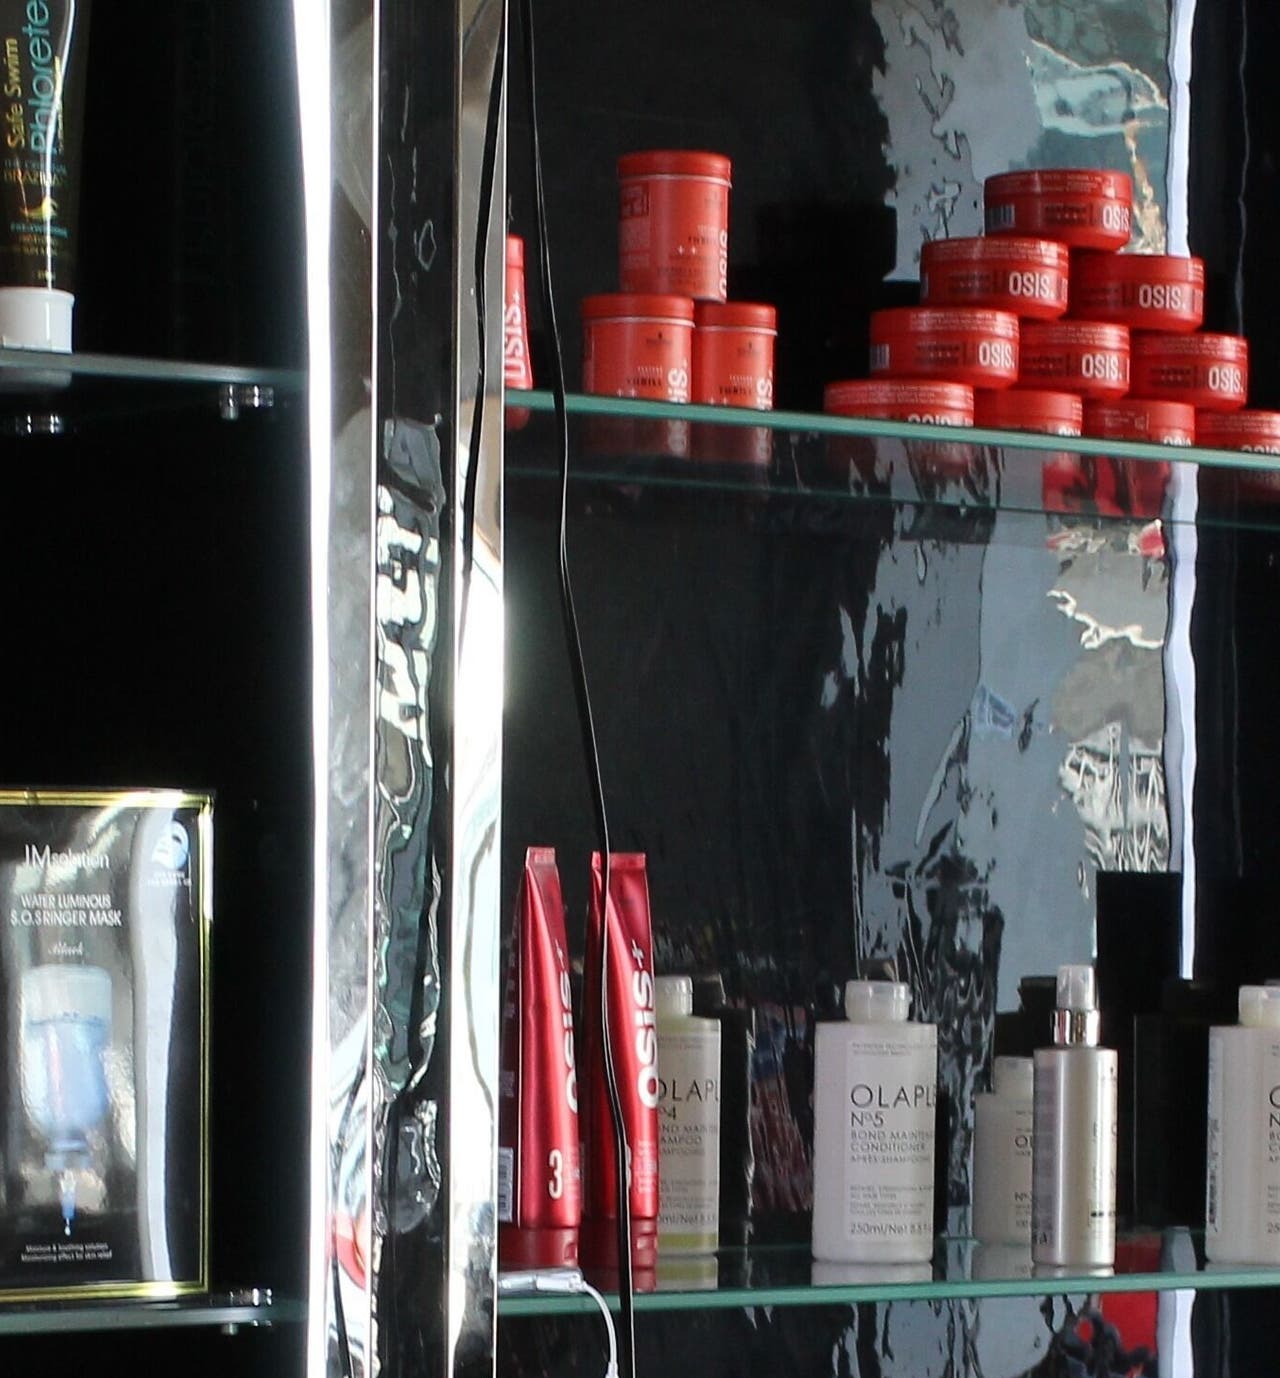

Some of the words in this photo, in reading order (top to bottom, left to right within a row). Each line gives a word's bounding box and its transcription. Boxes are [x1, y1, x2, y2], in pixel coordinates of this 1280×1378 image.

[21, 893, 55, 911] WATER
[58, 894, 111, 910] LUMINOUS
[42, 909, 87, 927] RINGER
[89, 909, 123, 927] MASK
[548, 1147, 563, 1200] 3
